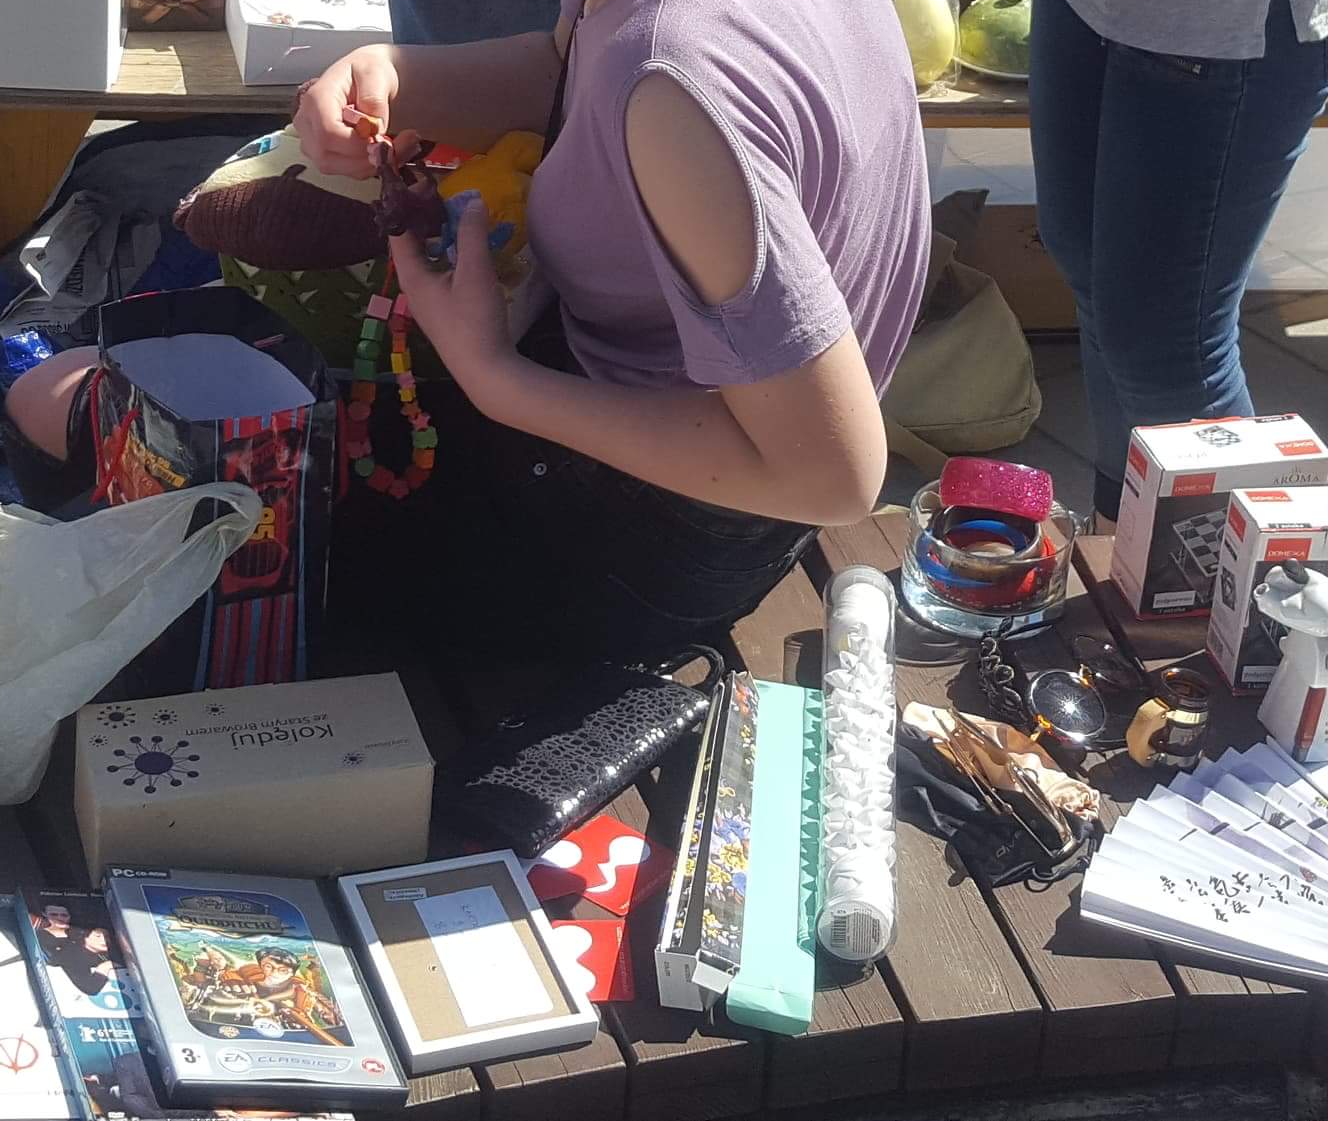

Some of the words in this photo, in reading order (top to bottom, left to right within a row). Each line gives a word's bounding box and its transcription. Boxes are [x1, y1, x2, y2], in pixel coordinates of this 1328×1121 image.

[1273, 472, 1320, 484] AROMA
[185, 720, 259, 737] Browarem
[261, 714, 312, 730] Starym
[230, 723, 334, 750] Kolęduj
[112, 868, 135, 877] PC
[257, 1056, 337, 1068] CLASSICS
